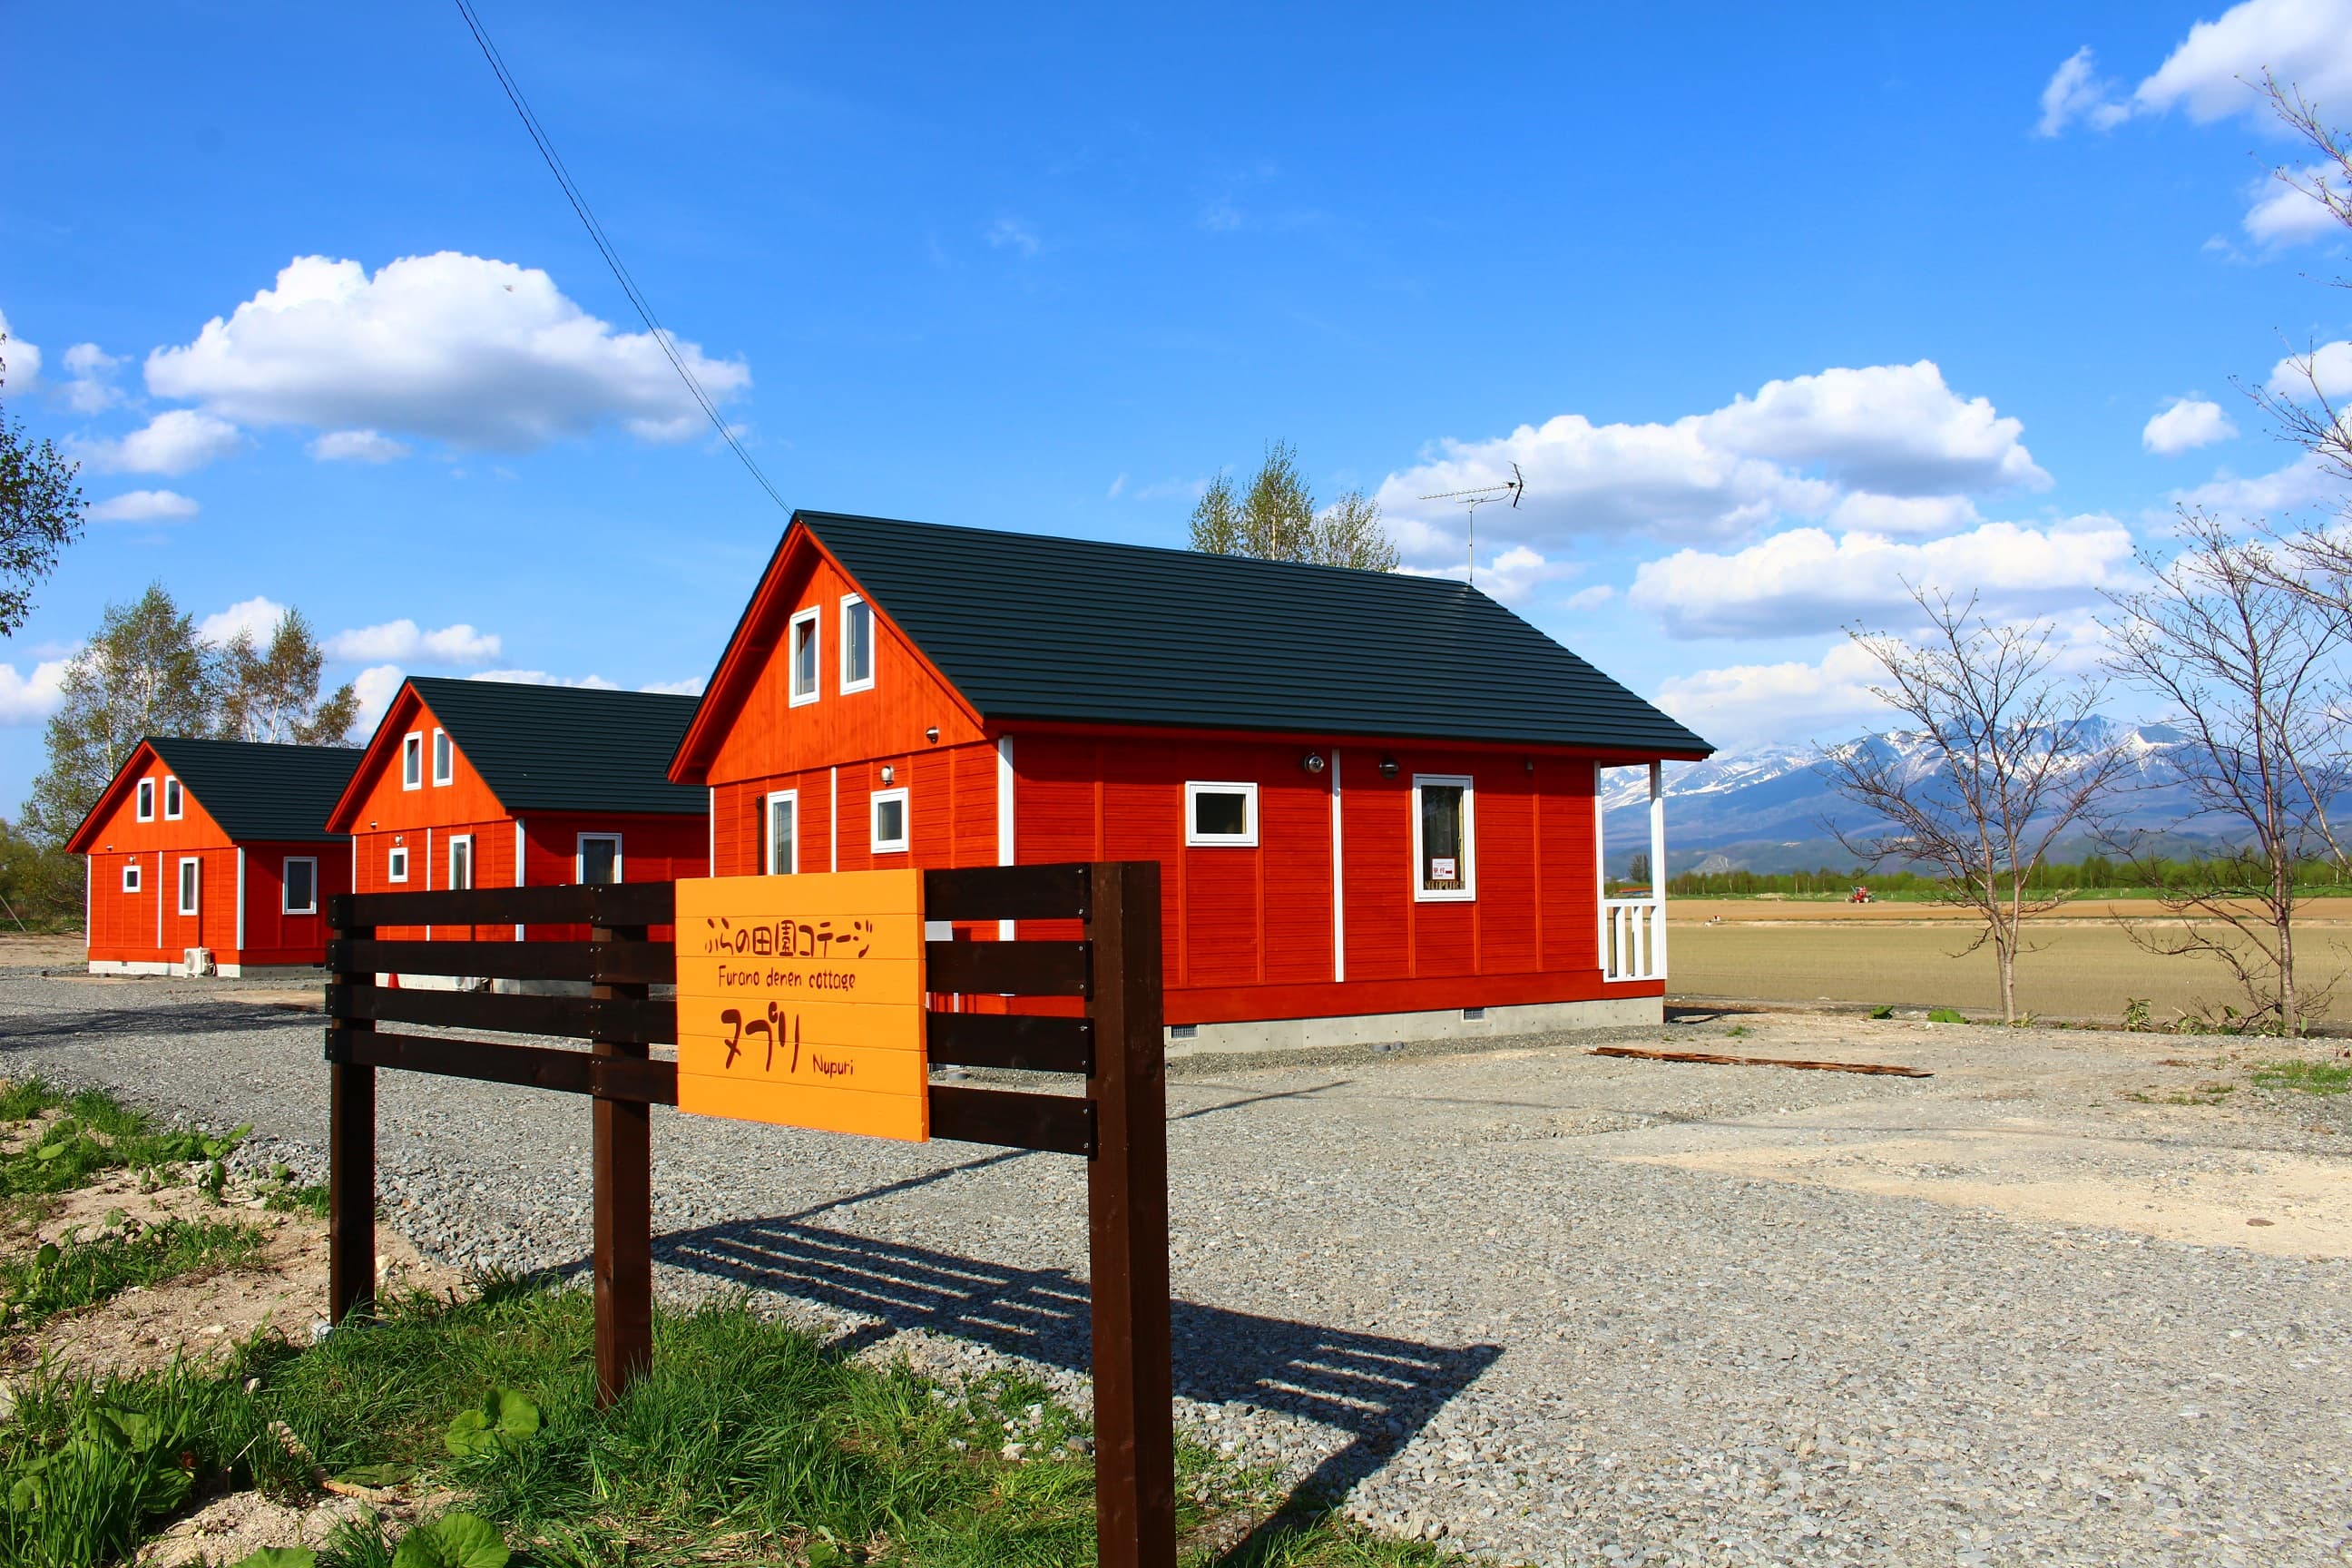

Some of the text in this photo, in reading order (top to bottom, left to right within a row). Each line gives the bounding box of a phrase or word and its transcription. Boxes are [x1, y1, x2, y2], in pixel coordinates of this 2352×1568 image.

[1425, 880, 1465, 890] NUPUR
[704, 917, 873, 958] ふらの田園コテージ
[719, 965, 856, 992] Furano denen cottage
[720, 1001, 800, 1073] ヌプリ
[812, 1054, 854, 1079] Nupuri
